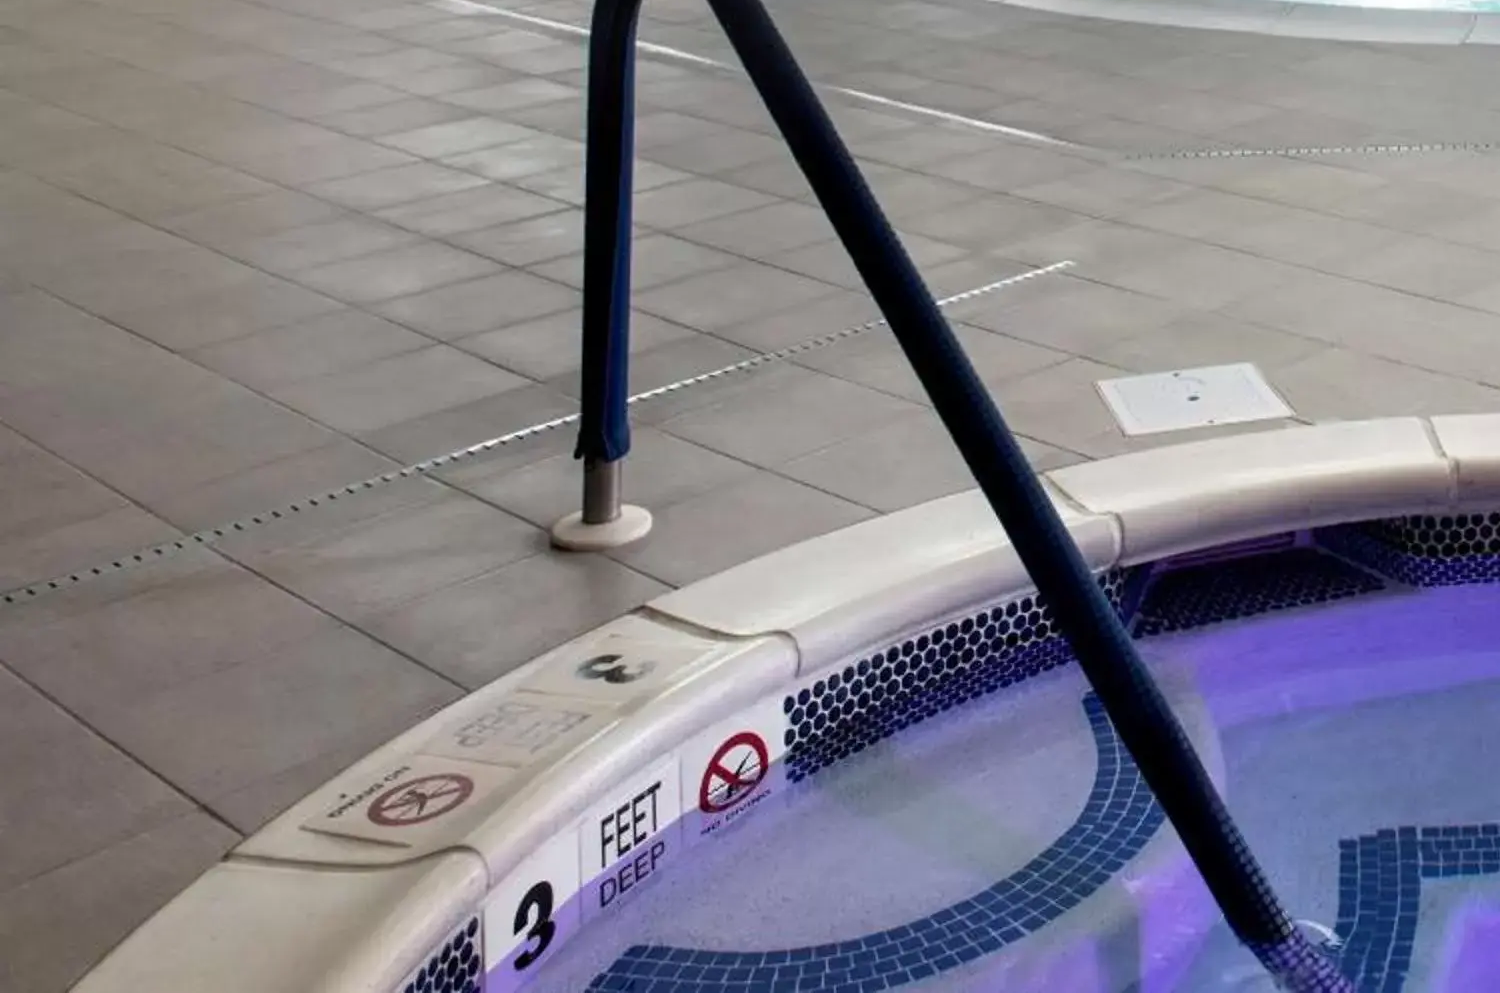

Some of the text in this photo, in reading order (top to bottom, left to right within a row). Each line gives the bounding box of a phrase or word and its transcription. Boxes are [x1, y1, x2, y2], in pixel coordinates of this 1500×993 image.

[513, 780, 663, 972] 3 FEET
[599, 842, 666, 908] DEEP
